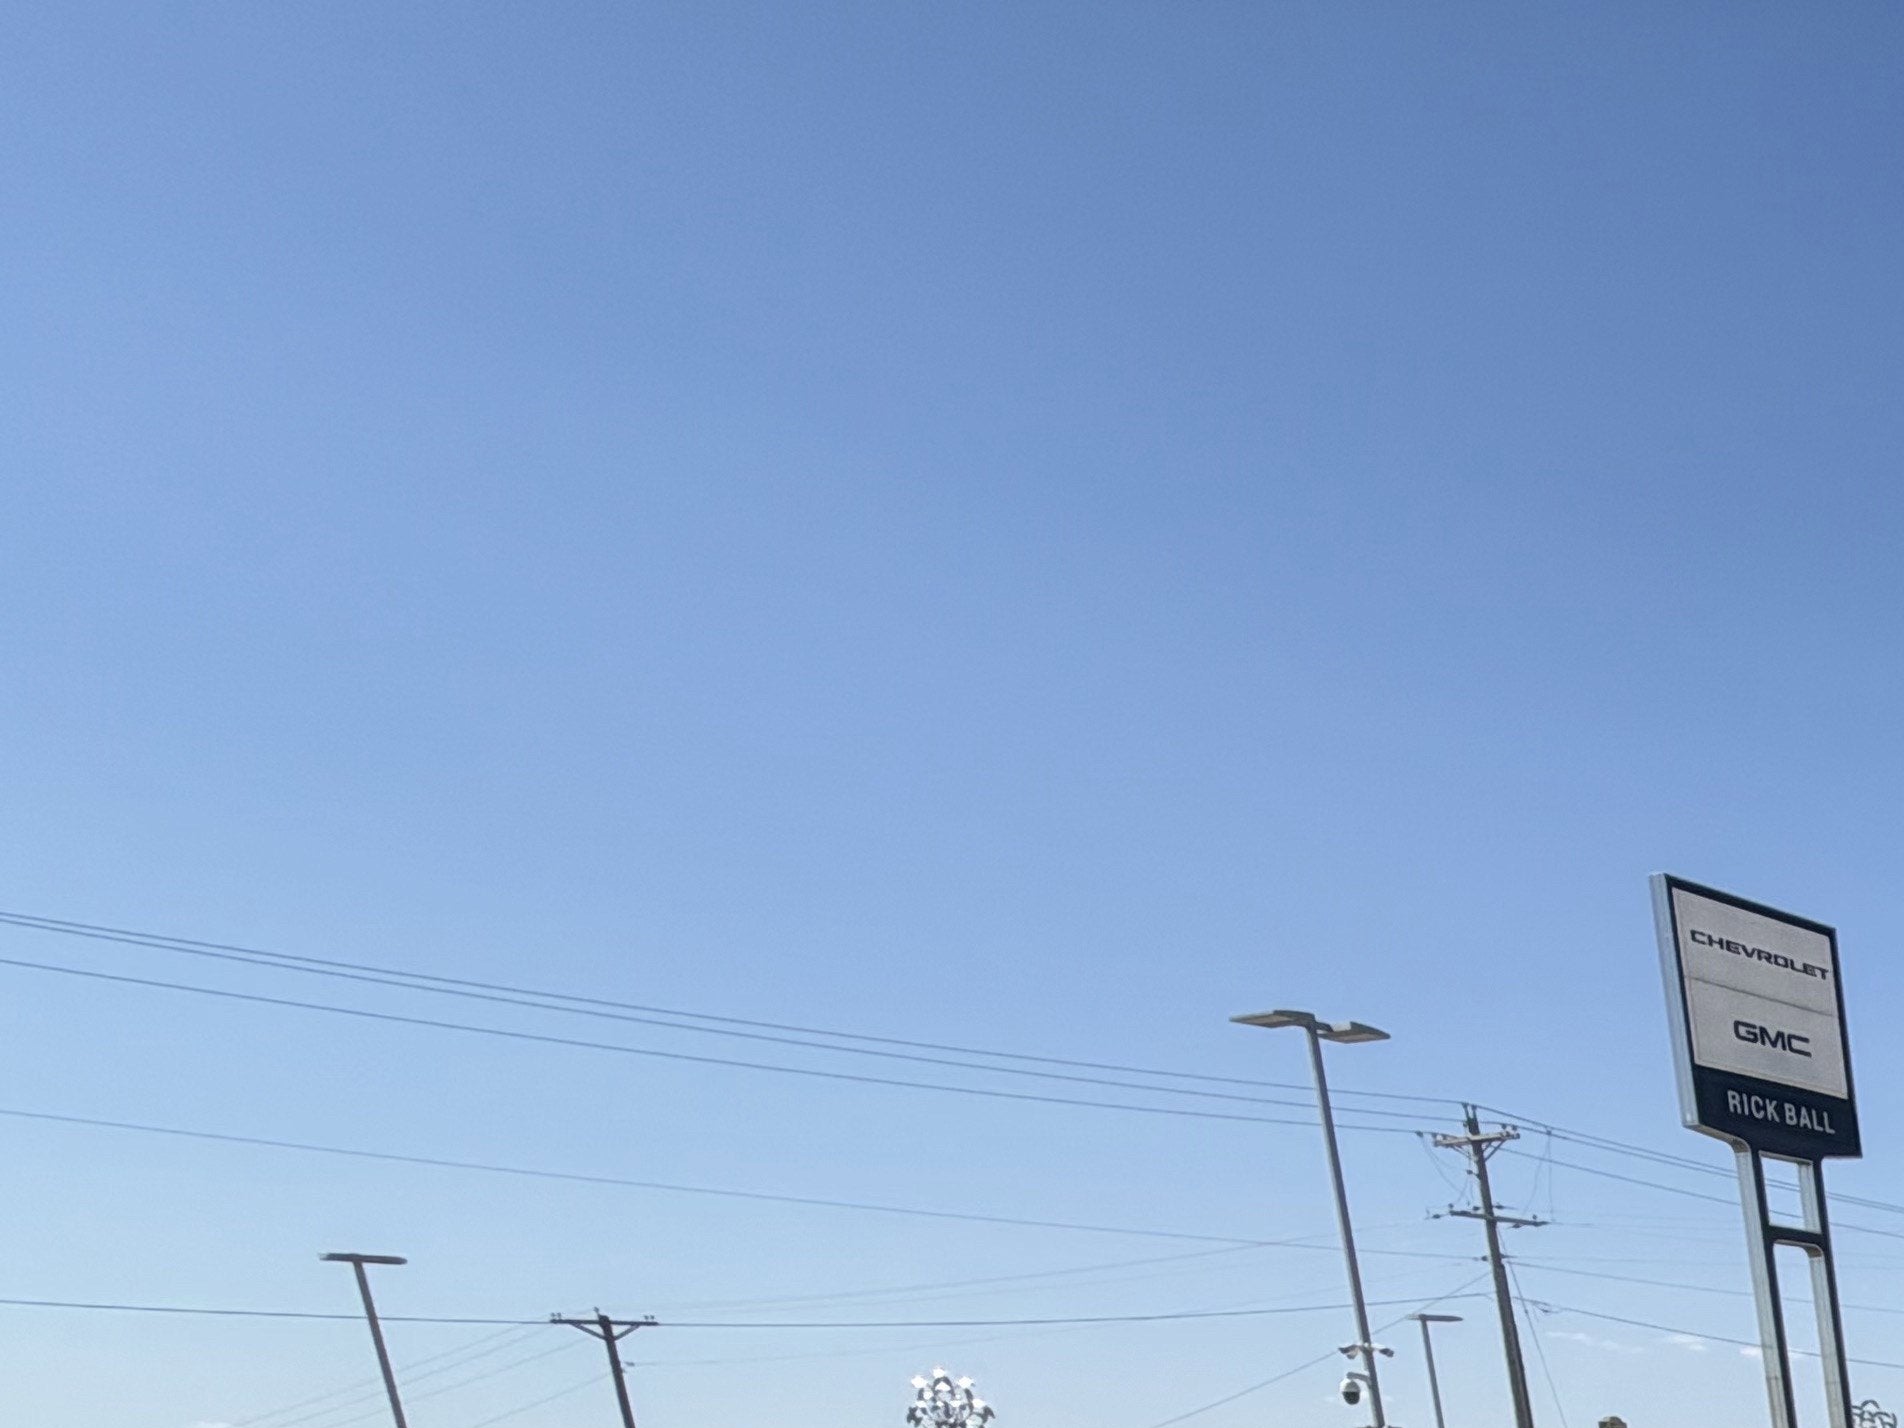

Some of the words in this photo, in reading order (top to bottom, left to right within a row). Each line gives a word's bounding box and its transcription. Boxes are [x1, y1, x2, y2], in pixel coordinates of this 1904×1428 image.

[1690, 929, 1829, 980] CHEVROLET
[1733, 1020, 1812, 1057] GMC
[1727, 1089, 1779, 1123] RICK
[1785, 1102, 1835, 1134] BALL
